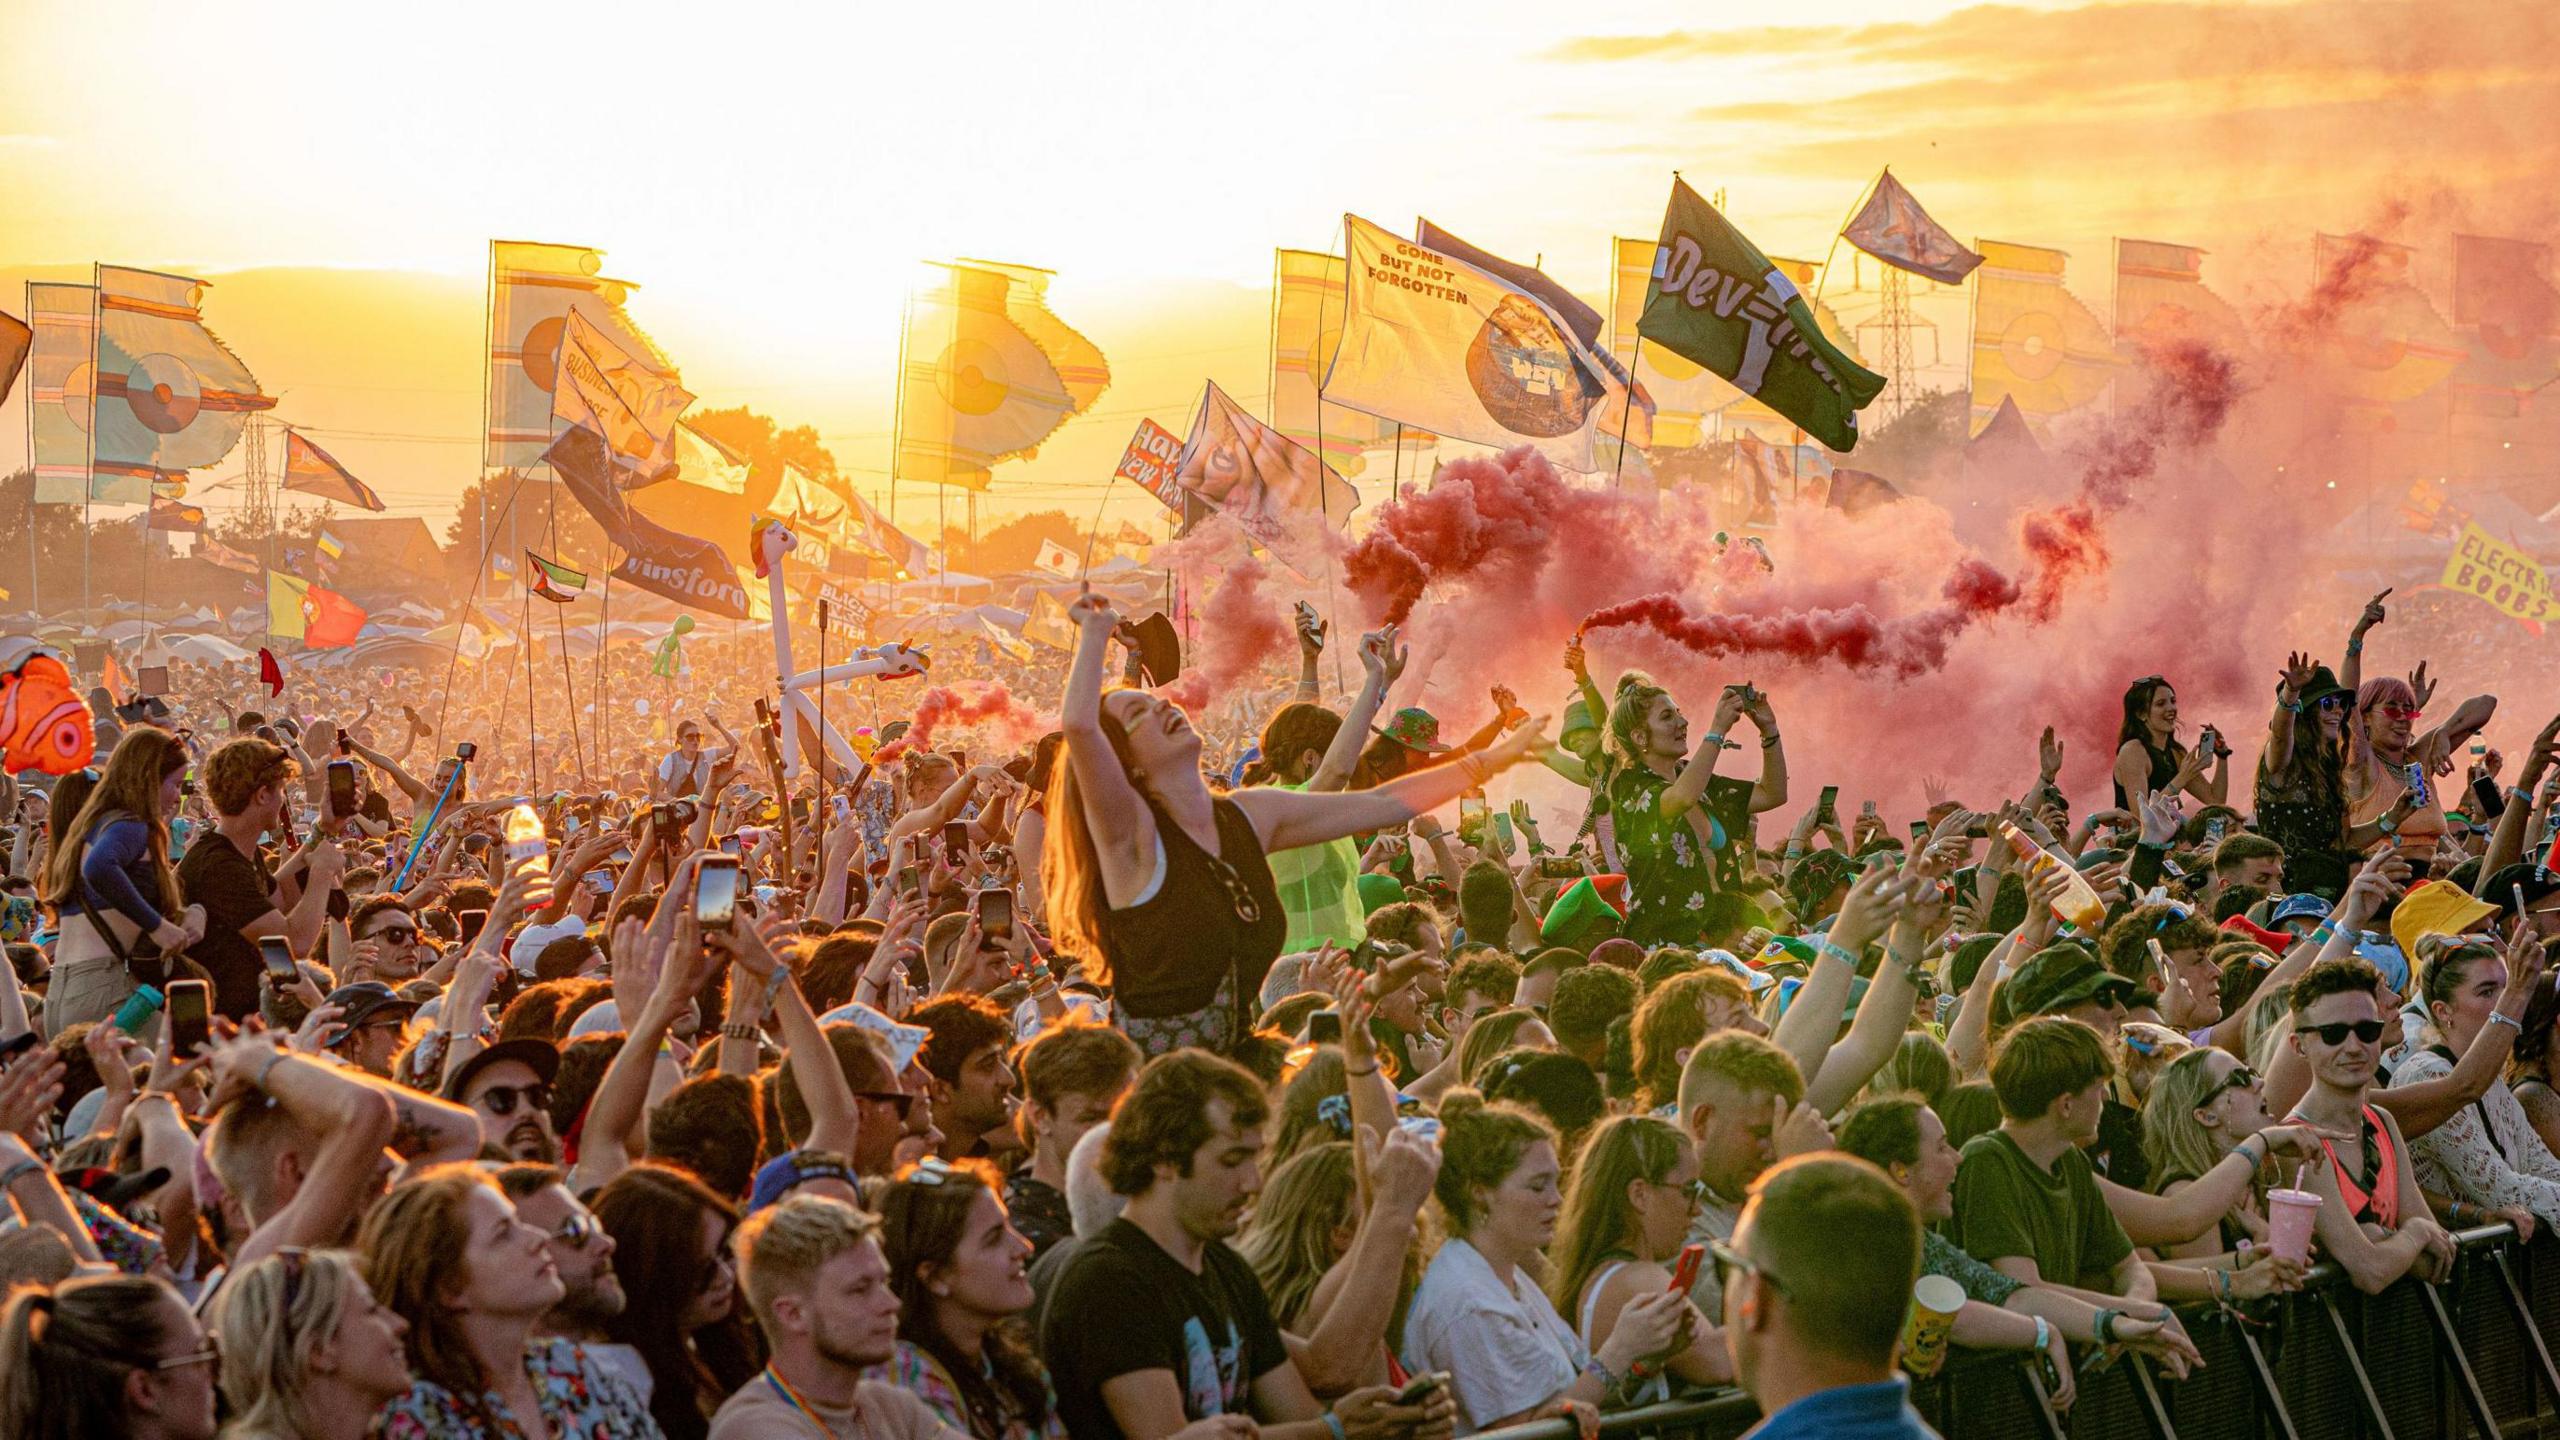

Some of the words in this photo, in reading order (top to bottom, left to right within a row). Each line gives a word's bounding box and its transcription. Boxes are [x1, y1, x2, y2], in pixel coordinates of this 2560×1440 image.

[1379, 252, 1410, 274] BUT
[1417, 264, 1455, 284] NOT
[1396, 243, 1444, 266] GONE
[1368, 266, 1468, 305] FORGOTTEN
[2456, 564, 2549, 617] BOOBS
